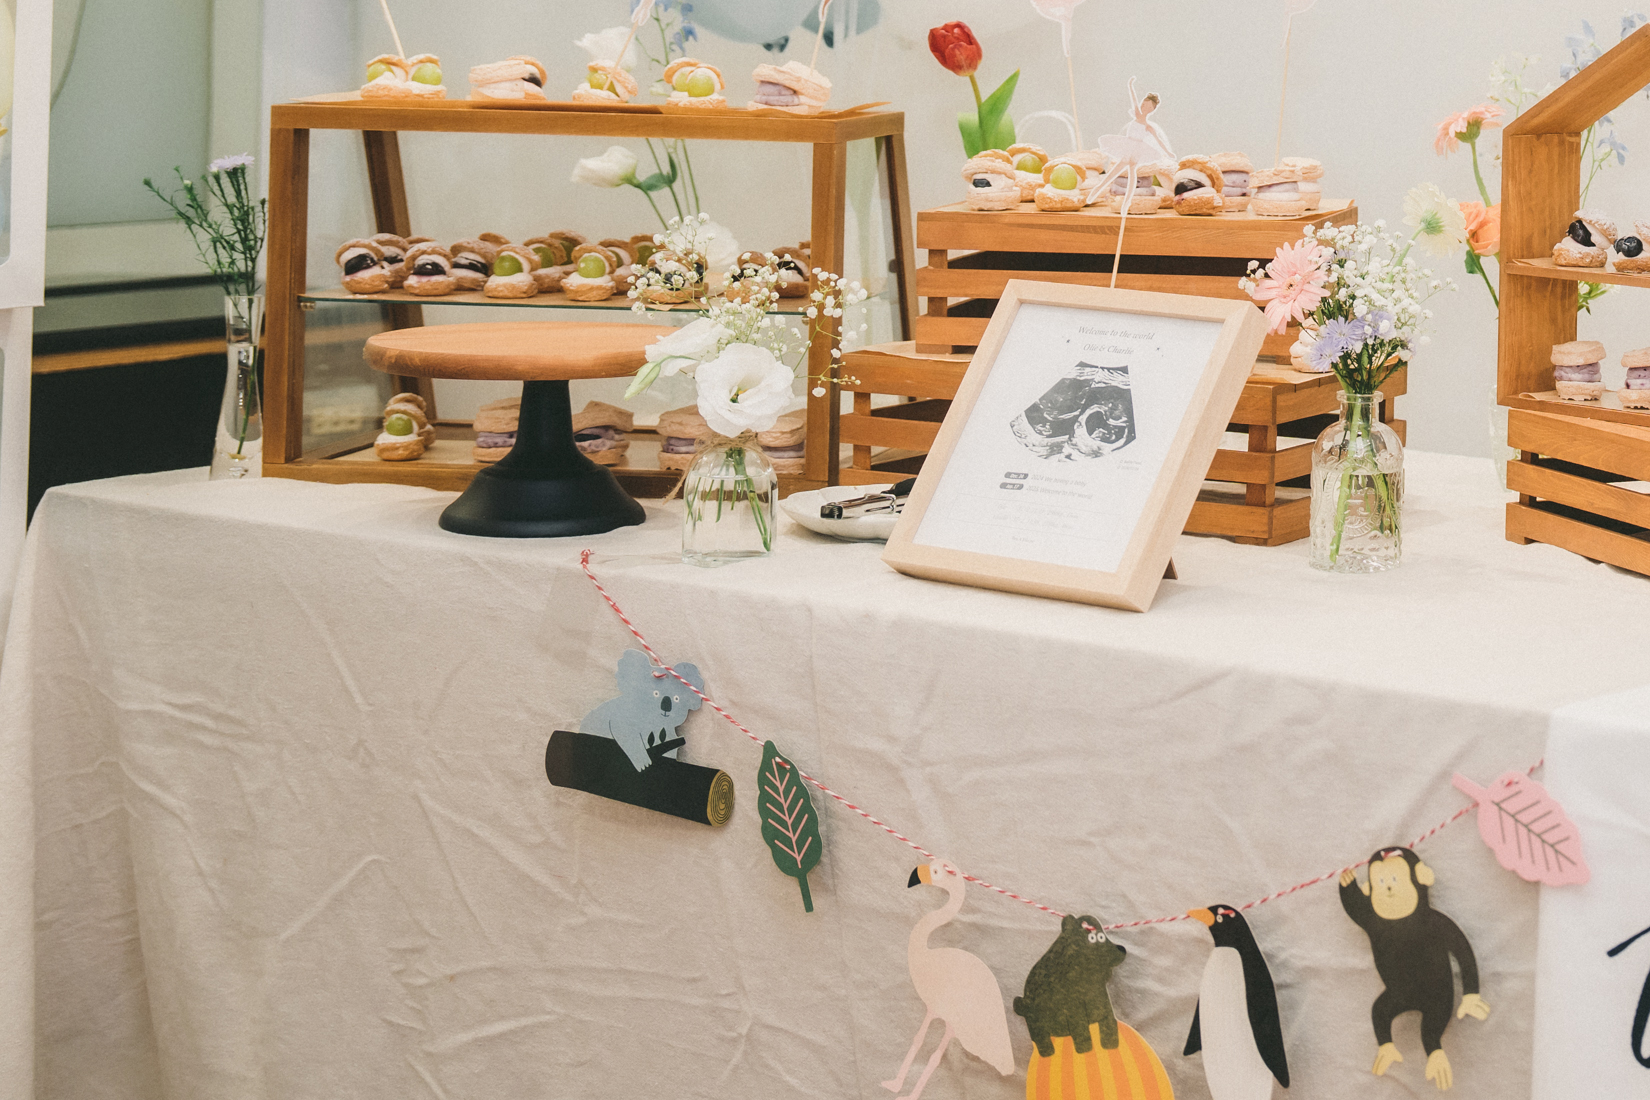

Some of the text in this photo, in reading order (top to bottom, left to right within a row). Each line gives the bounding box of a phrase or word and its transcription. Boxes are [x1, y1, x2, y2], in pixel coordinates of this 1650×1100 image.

[1078, 326, 1156, 341] Welcome to the world
[1107, 345, 1135, 355] Charlie
